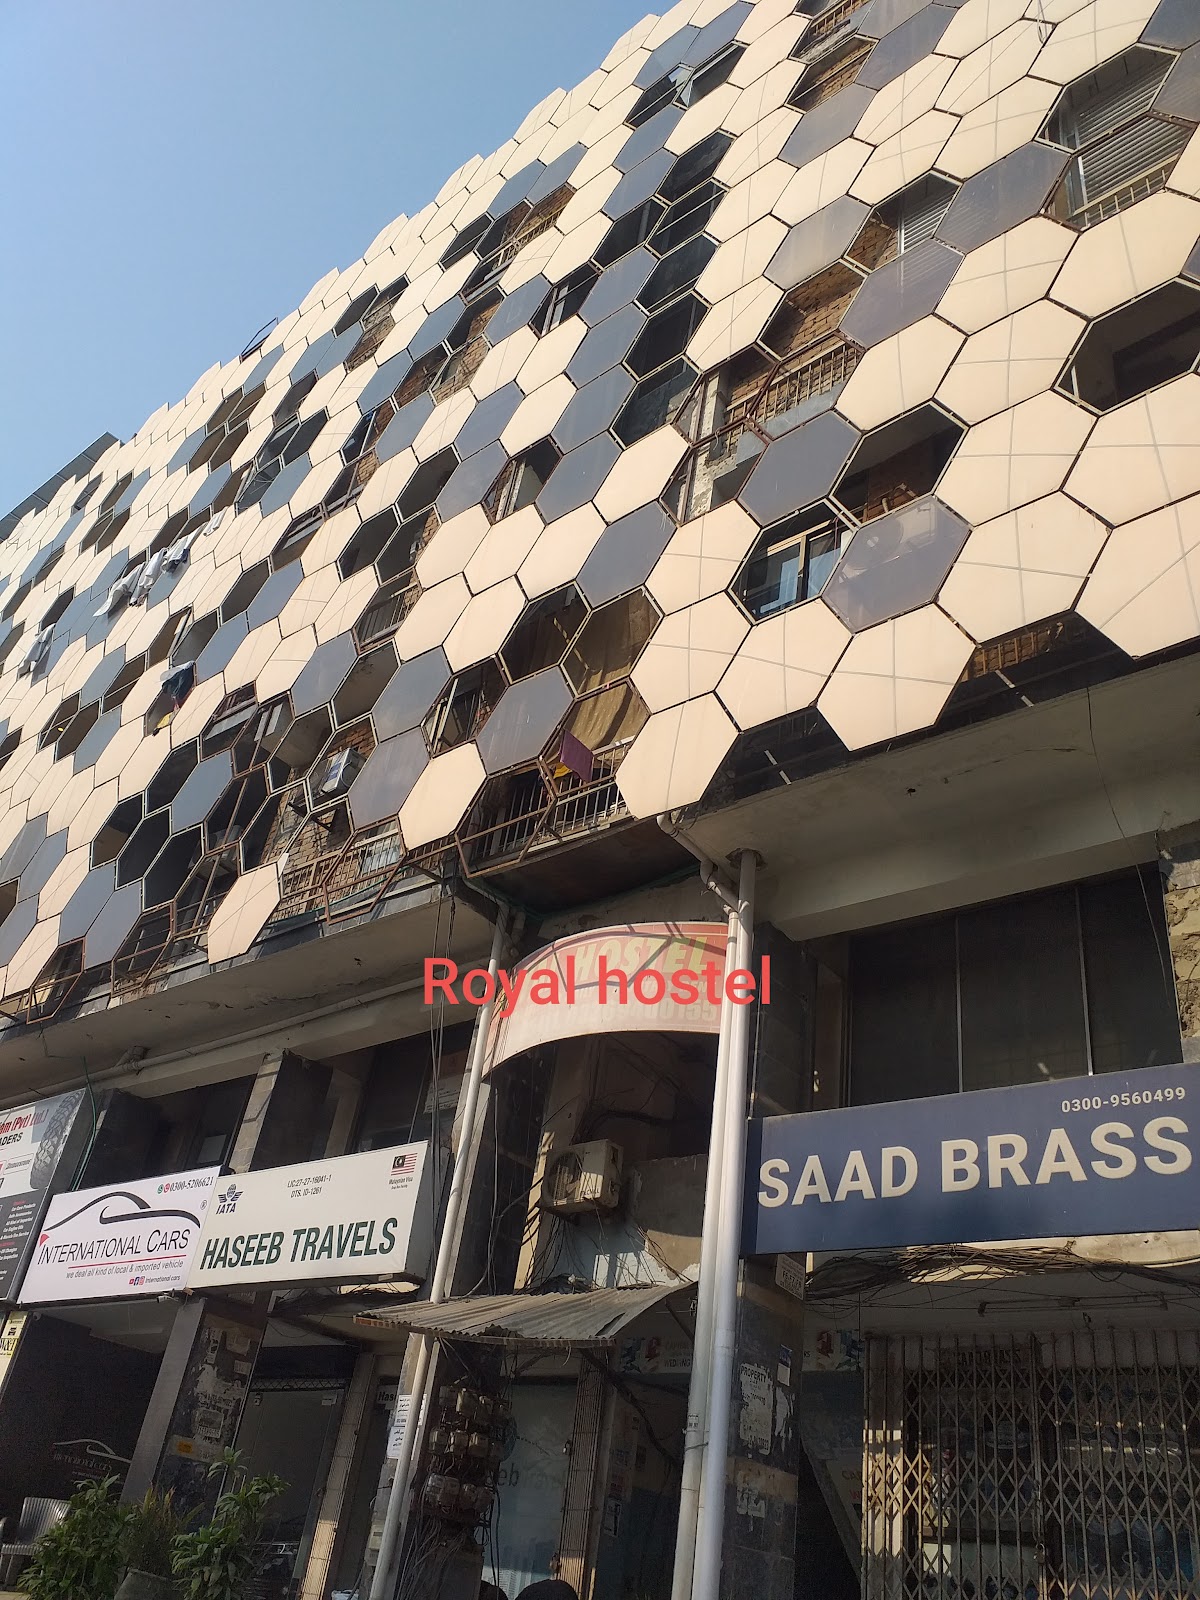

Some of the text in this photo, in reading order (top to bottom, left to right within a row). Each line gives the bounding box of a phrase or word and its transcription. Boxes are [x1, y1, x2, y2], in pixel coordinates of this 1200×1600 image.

[1061, 1086, 1186, 1114] 0300-9560499
[758, 1116, 1193, 1209] SAAD BRASS
[215, 1202, 237, 1215] IATA
[37, 1228, 191, 1265] INTERNATIONAL CARS
[199, 1217, 398, 1270] HASEEB TRAVELS
[74, 1269, 87, 1278] deal
[87, 1268, 95, 1277] all
[95, 1266, 107, 1276] kind
[107, 1265, 114, 1275] of
[114, 1264, 128, 1274] local
[134, 1261, 161, 1273] imported
[161, 1259, 184, 1269] vehicle
